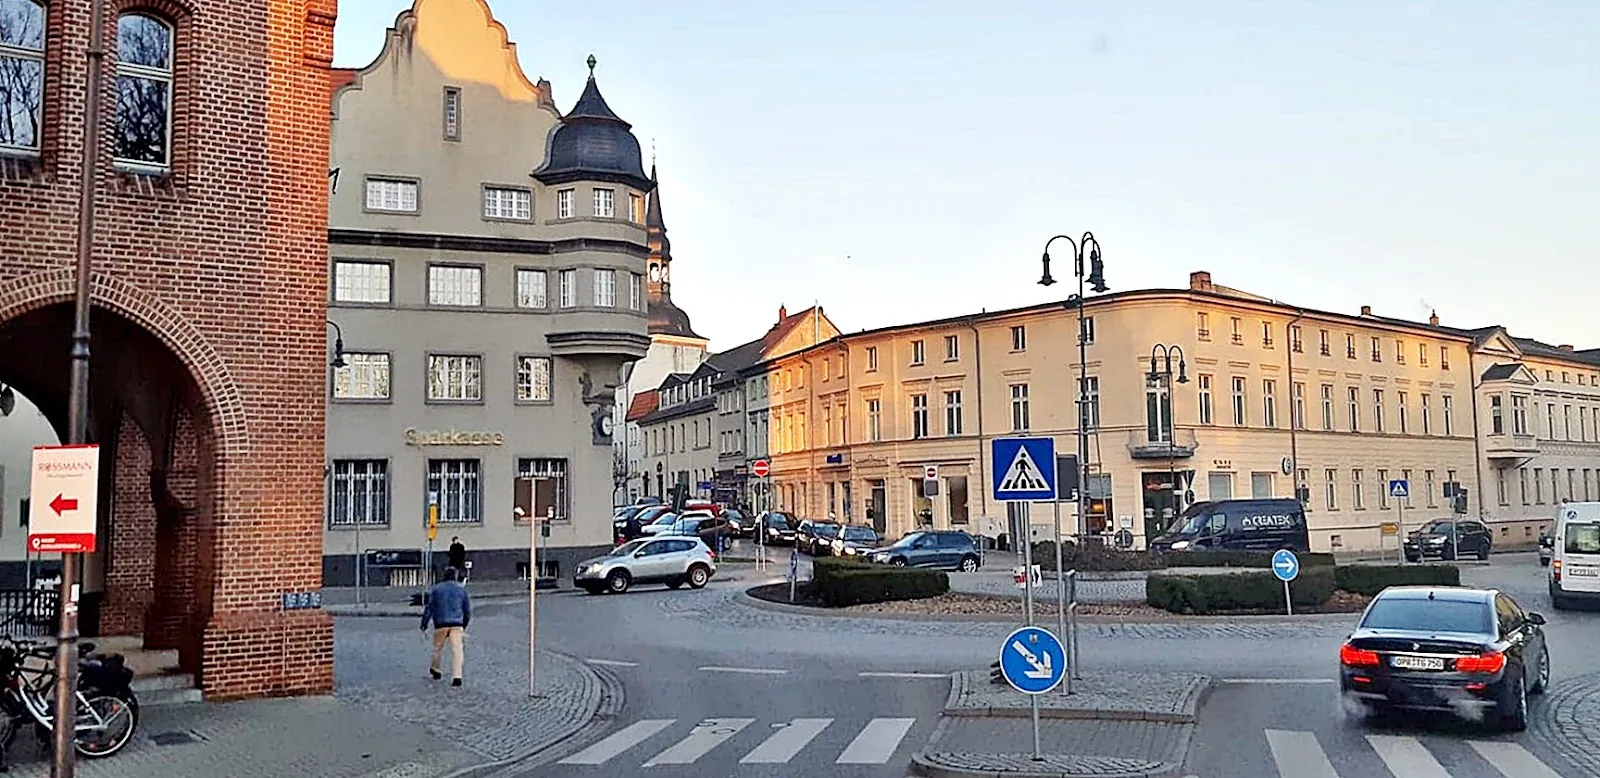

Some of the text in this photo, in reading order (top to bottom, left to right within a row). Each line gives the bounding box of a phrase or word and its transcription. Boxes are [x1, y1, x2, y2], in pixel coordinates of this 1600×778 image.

[404, 427, 504, 448] Sparkasse
[38, 462, 92, 471] ROSSMANN
[1252, 514, 1292, 526] CREATEX
